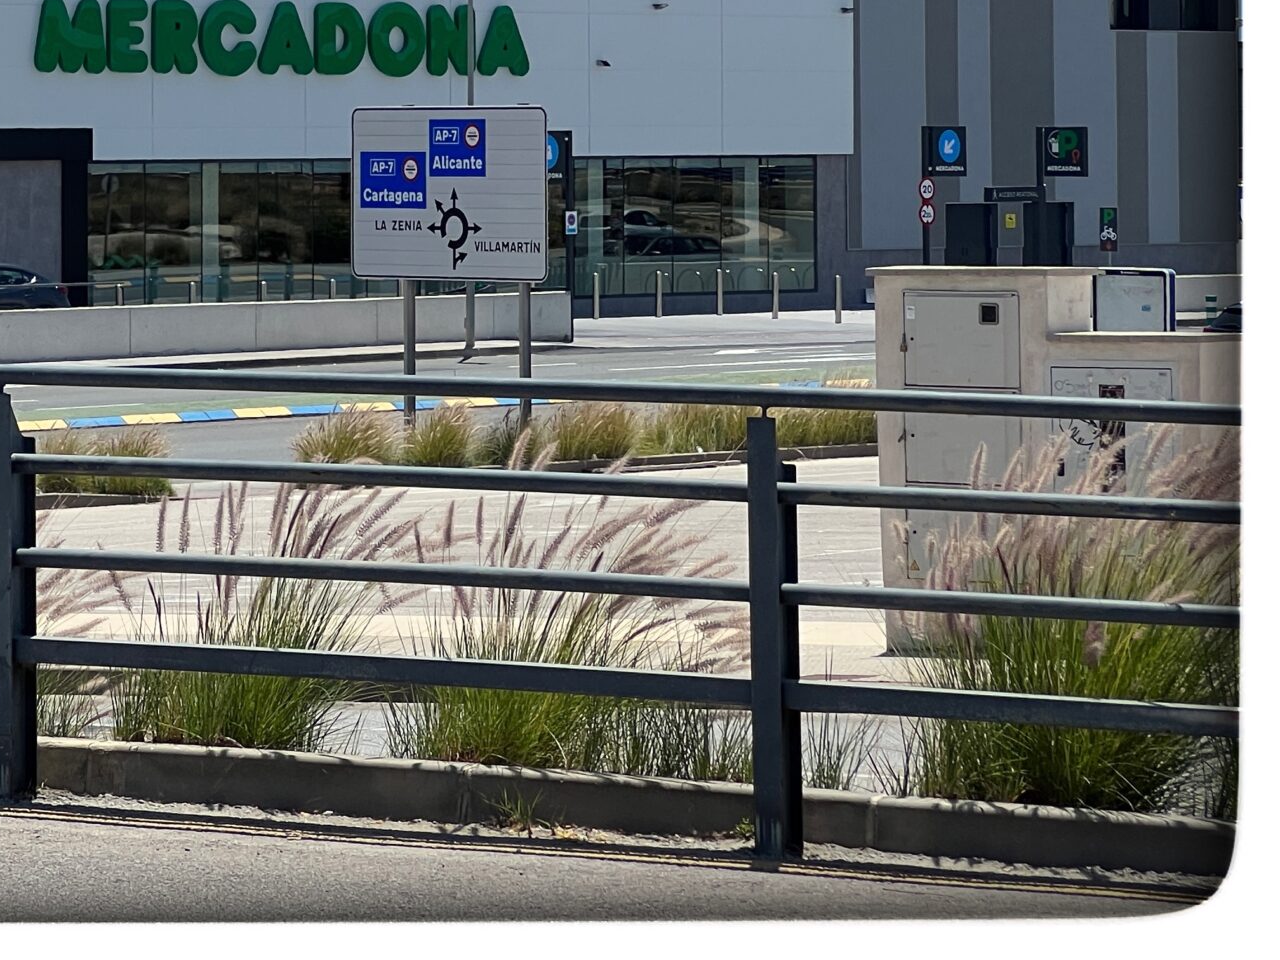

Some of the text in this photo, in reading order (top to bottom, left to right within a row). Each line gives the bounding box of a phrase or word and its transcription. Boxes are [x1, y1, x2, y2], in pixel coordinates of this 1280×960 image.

[435, 130, 457, 142] AP-7
[372, 161, 394, 173] AP-7
[432, 155, 483, 170] Alicante
[922, 184, 933, 194] 20
[363, 188, 424, 205] Cartagena
[375, 220, 423, 231] LA ZENIA
[474, 239, 541, 254] VILLAMARTÍN
